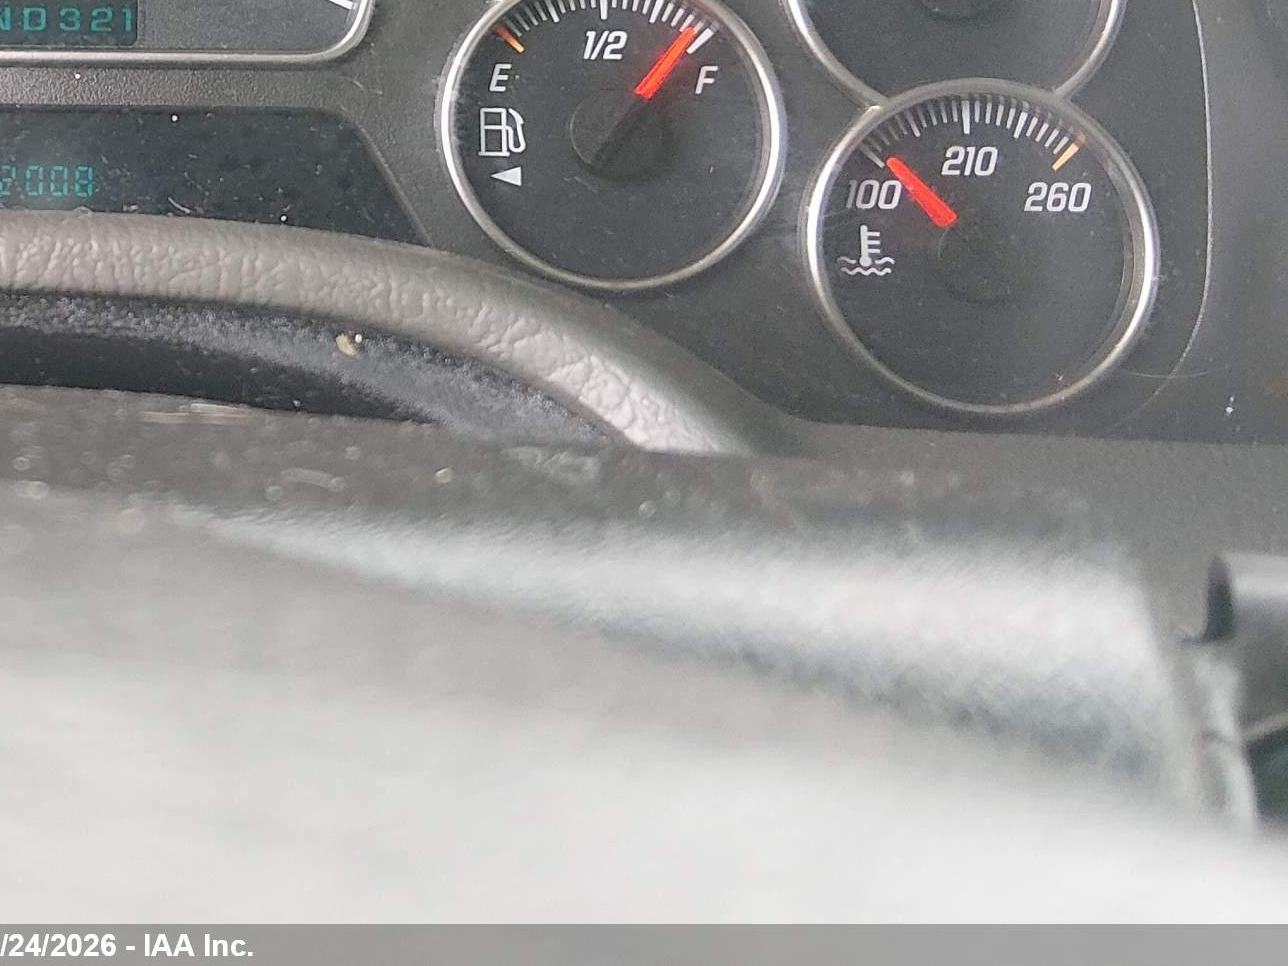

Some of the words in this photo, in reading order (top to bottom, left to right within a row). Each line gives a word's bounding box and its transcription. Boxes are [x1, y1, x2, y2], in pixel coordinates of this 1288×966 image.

[584, 31, 627, 59] 1/2
[490, 64, 511, 91] E
[696, 66, 718, 93] F
[942, 146, 997, 175] 210
[846, 180, 903, 209] 100
[1024, 183, 1091, 211] 260
